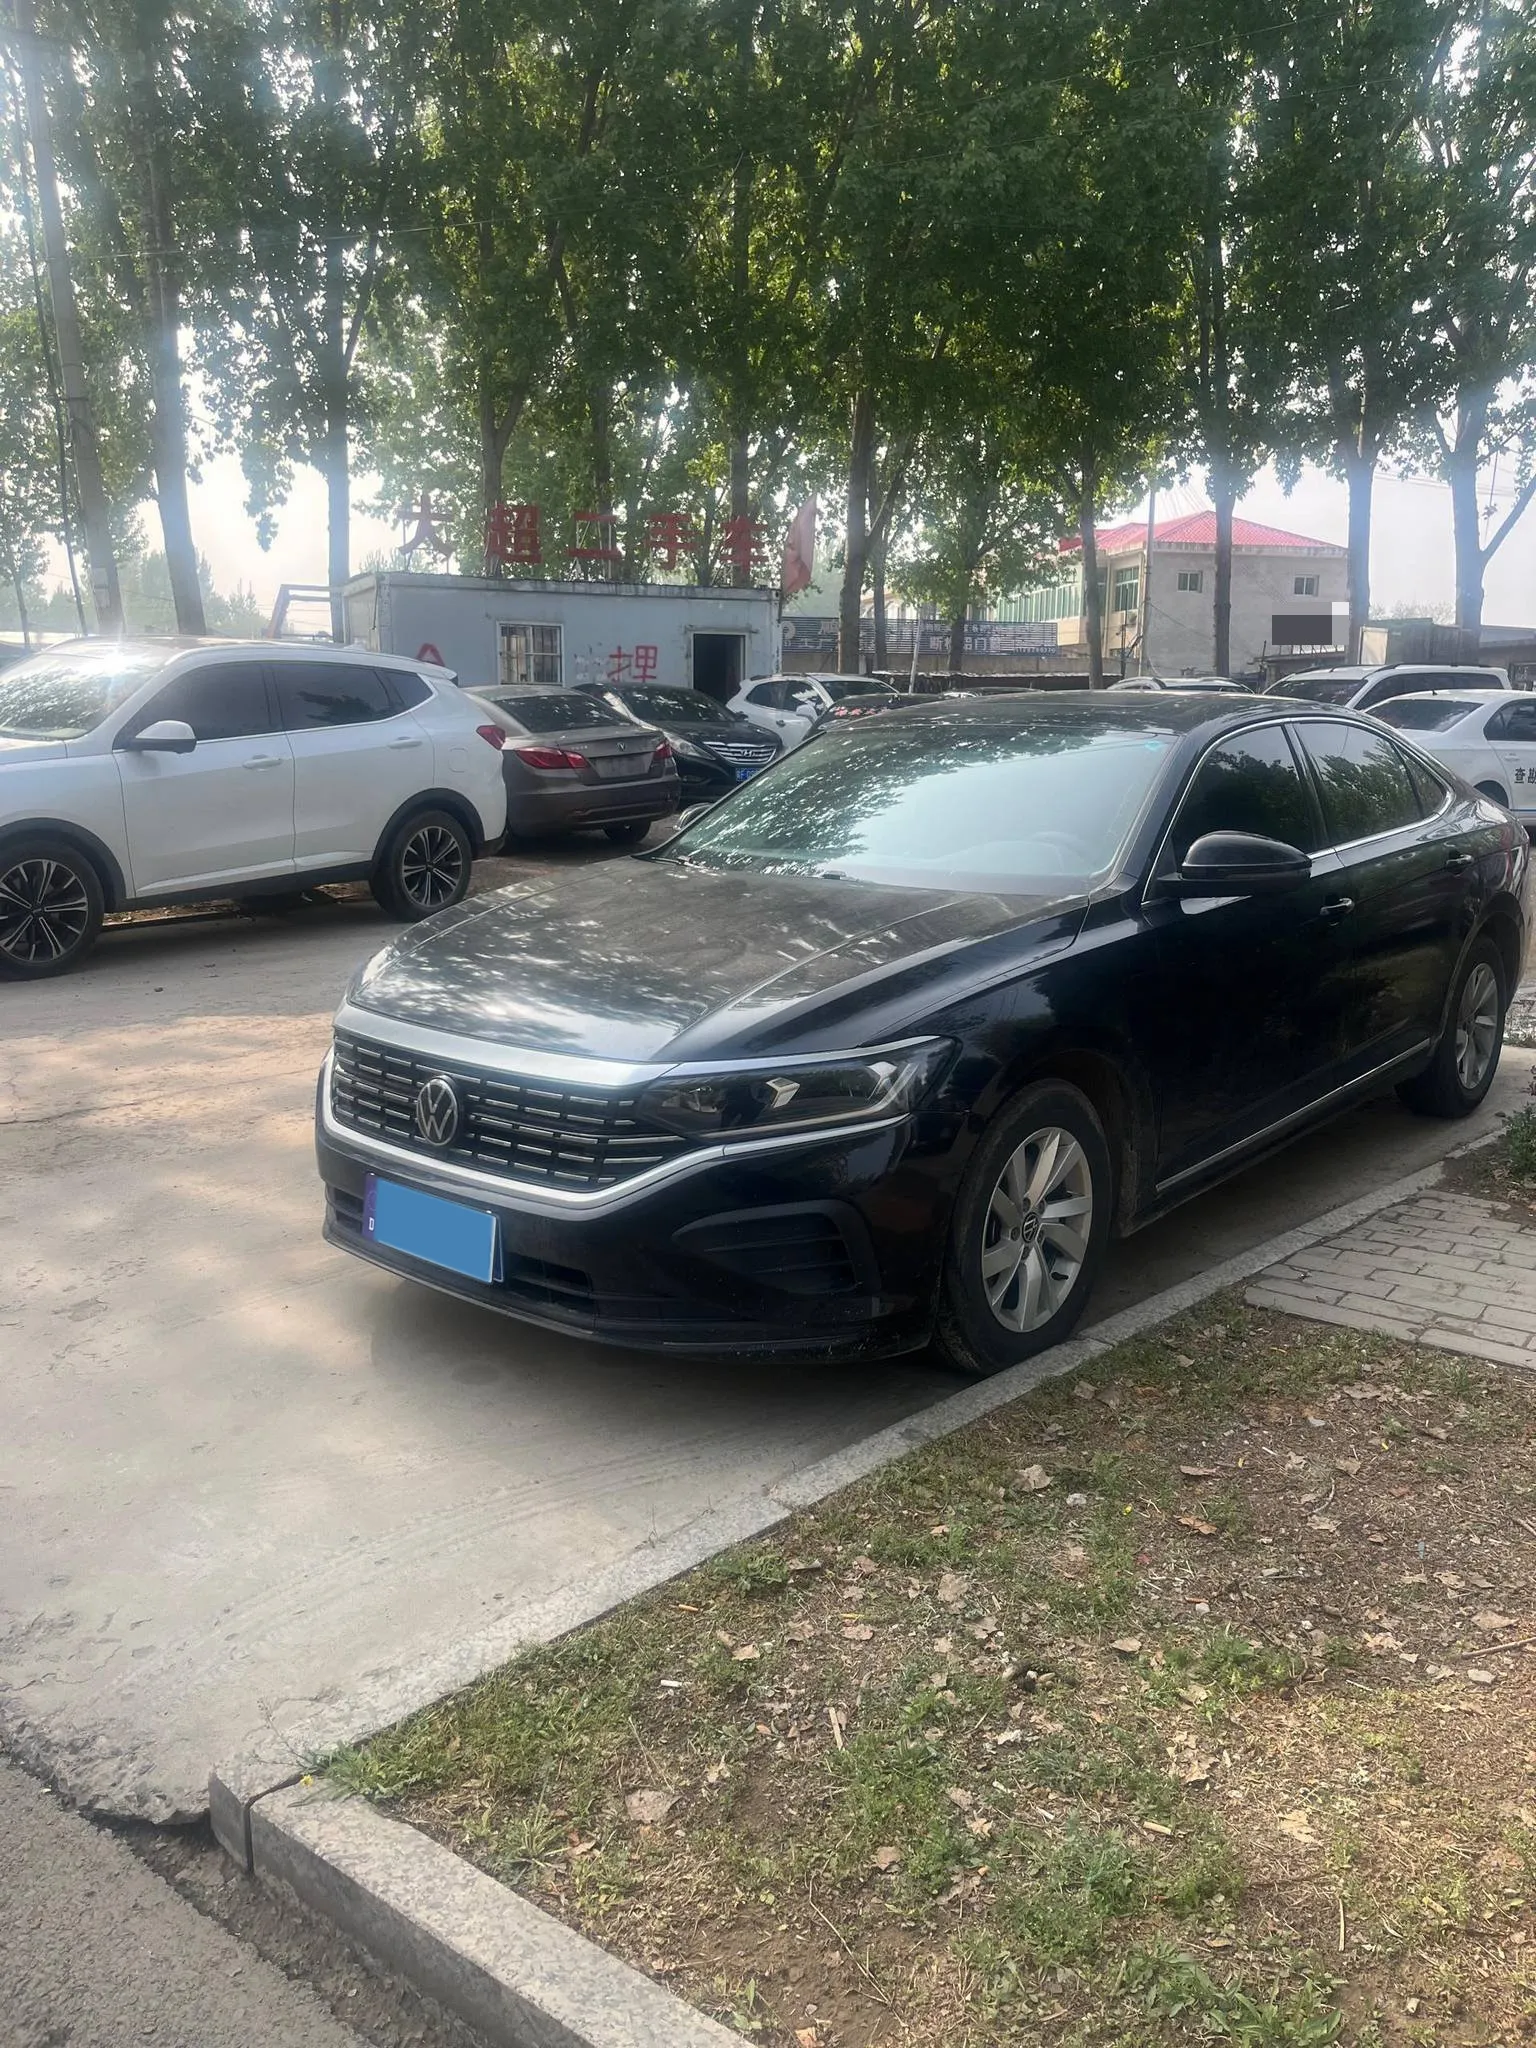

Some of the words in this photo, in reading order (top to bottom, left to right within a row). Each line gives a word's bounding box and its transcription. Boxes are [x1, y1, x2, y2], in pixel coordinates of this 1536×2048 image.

[399, 496, 769, 573] 大超二手车
[929, 636, 1002, 651] 断门窗
